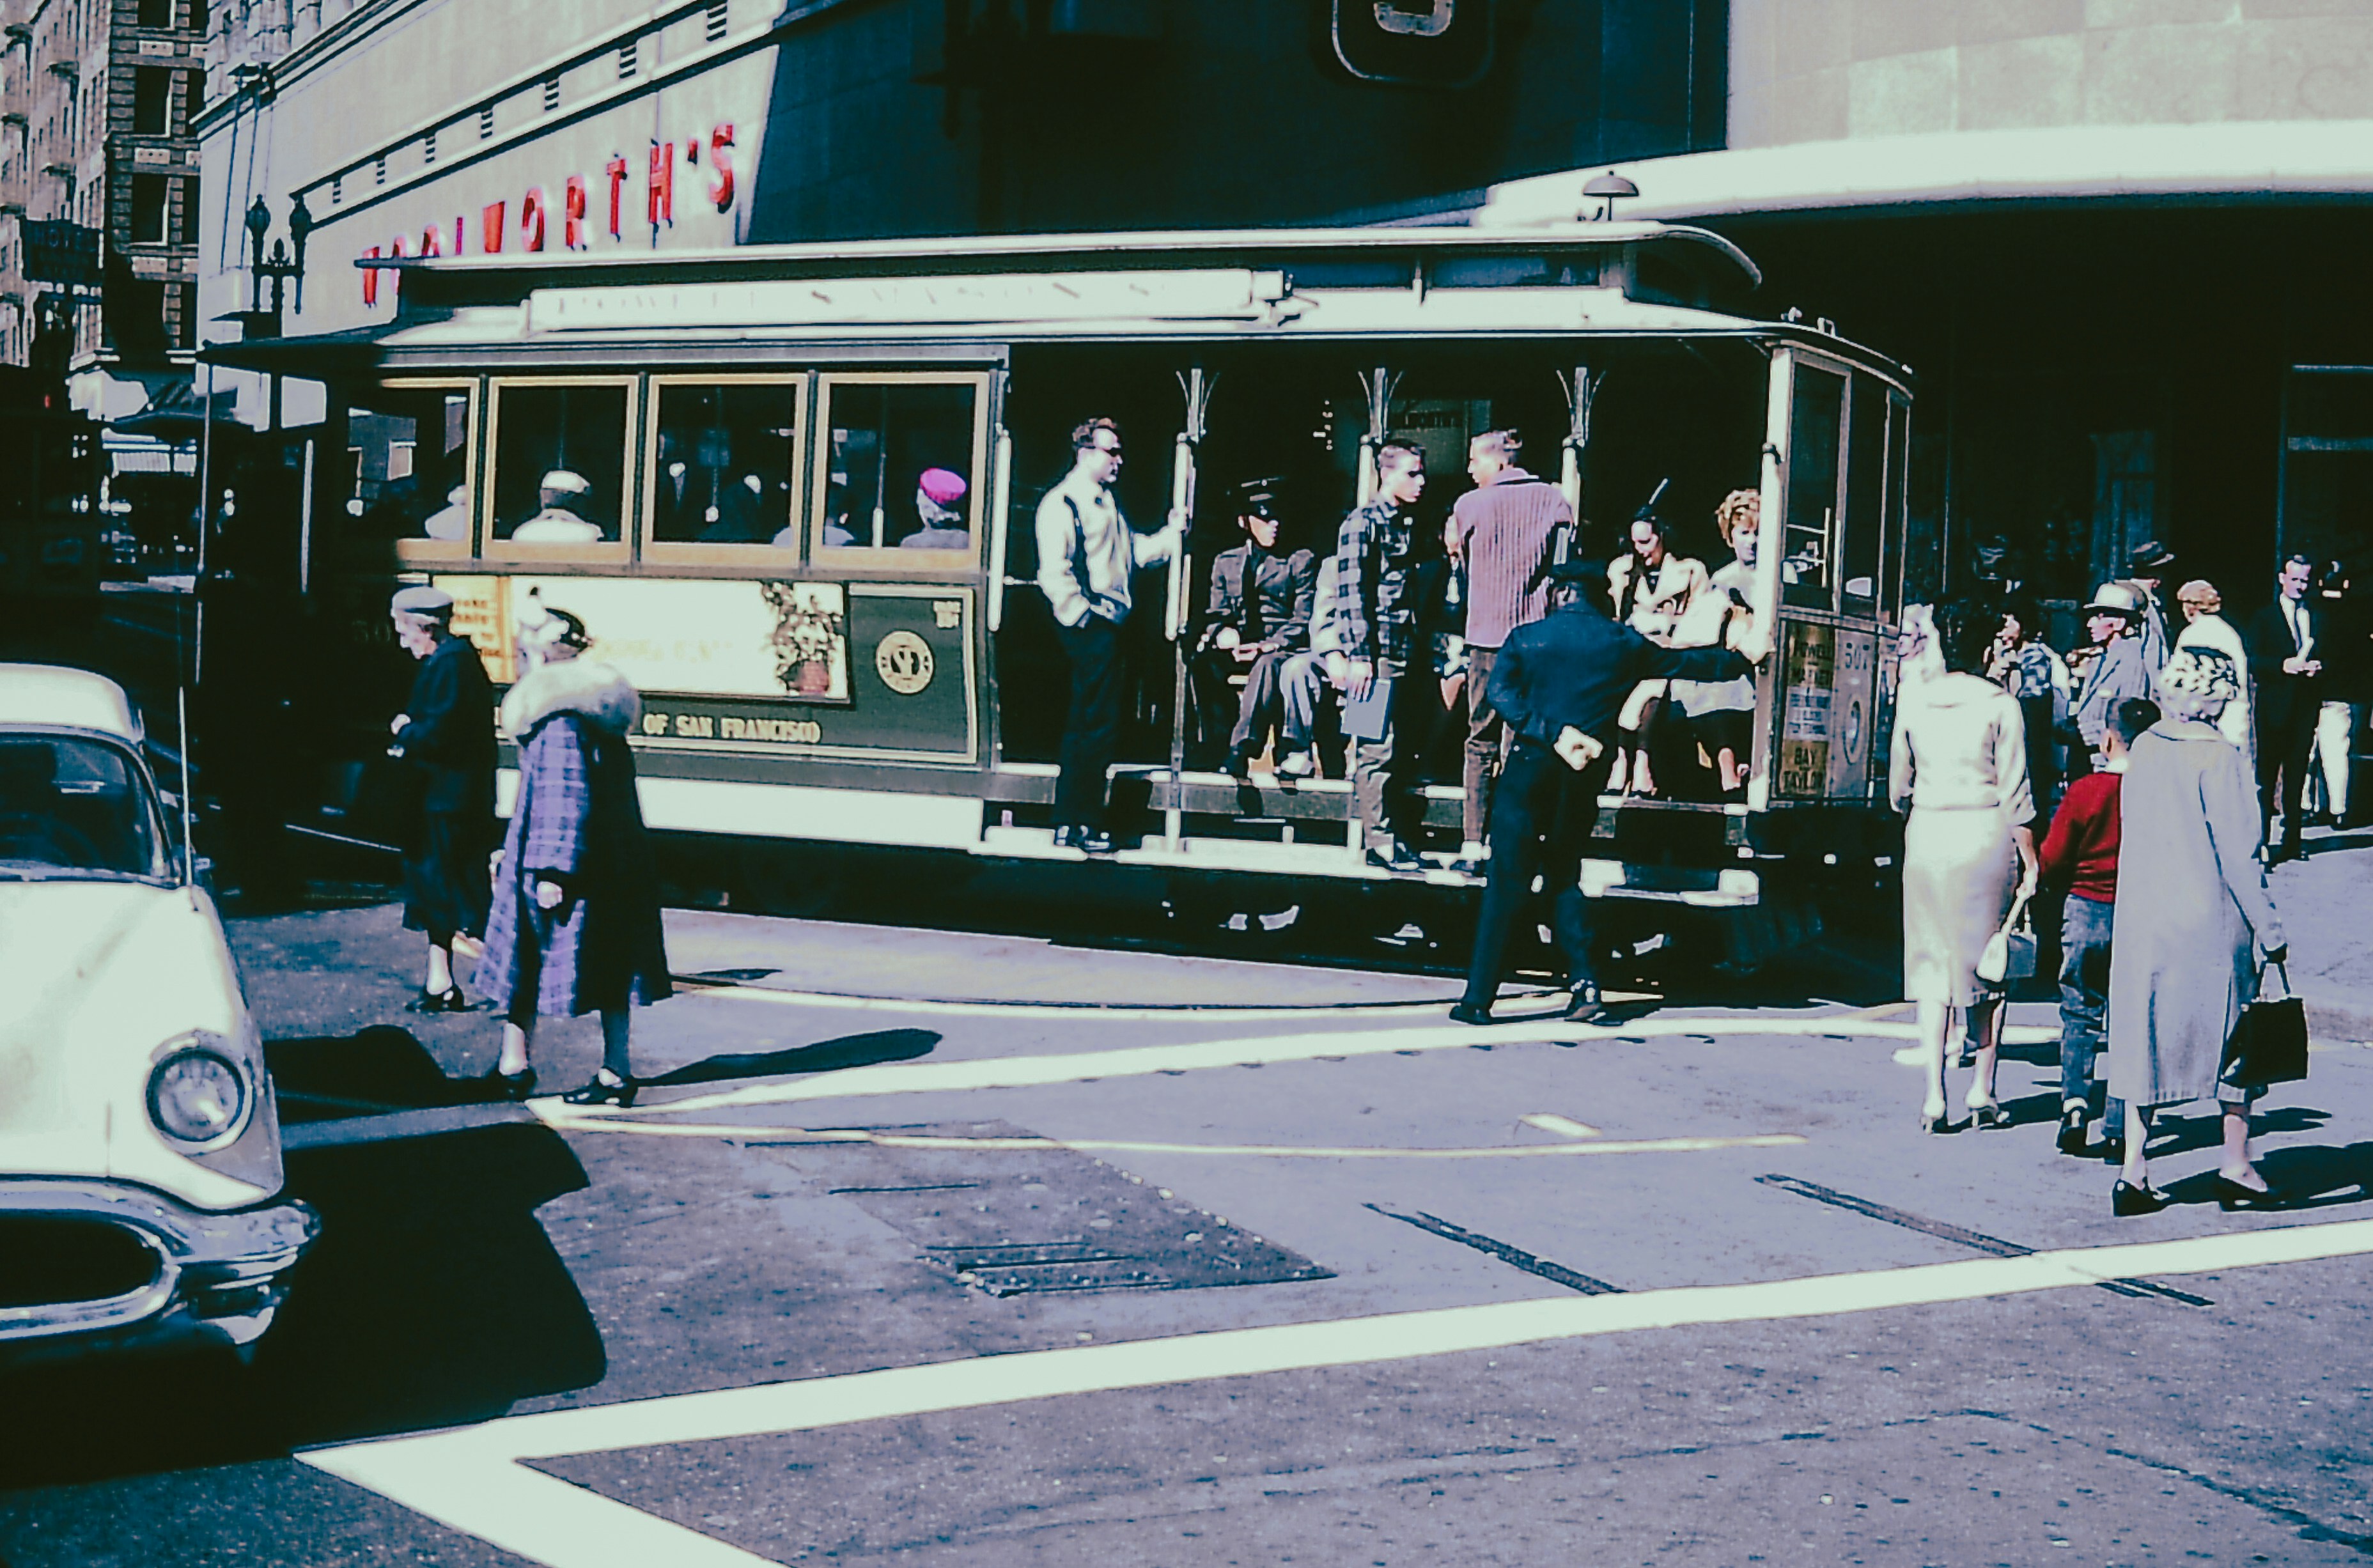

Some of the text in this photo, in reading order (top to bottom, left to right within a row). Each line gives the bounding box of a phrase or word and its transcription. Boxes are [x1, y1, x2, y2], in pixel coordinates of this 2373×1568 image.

[643, 713, 821, 743] OF SAN FRANCISCO
[1794, 747, 1817, 765] BAY
[1784, 770, 1823, 789] TAYLOR
